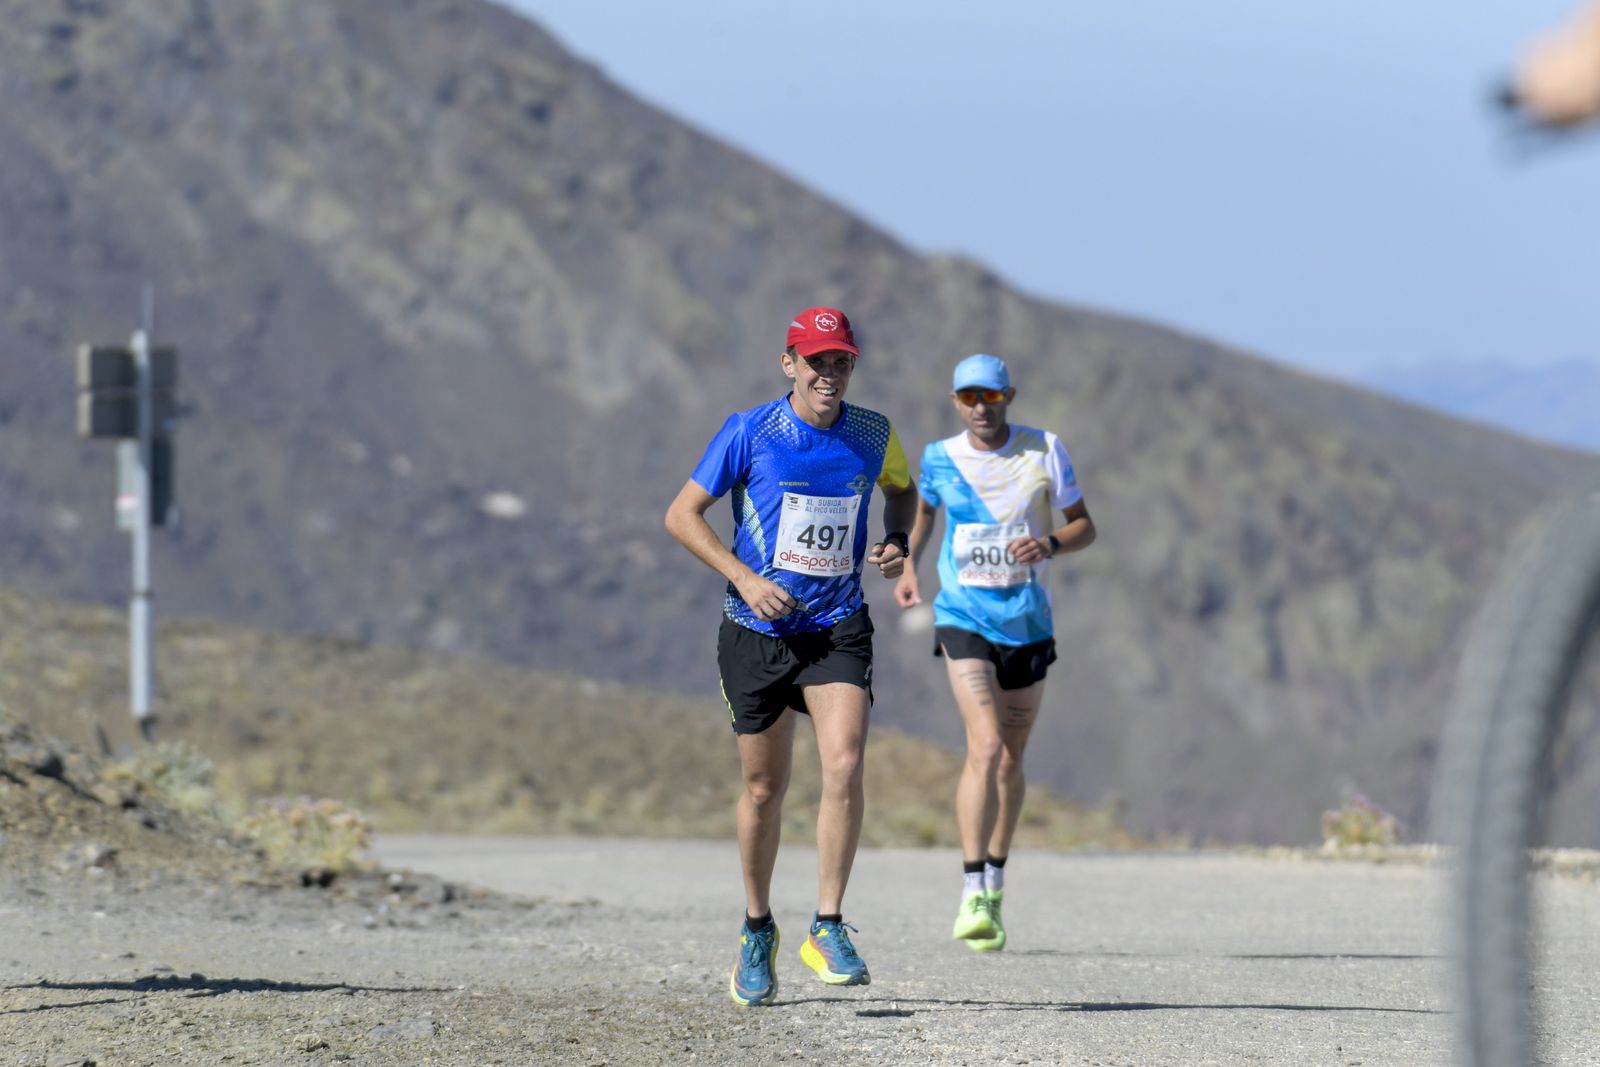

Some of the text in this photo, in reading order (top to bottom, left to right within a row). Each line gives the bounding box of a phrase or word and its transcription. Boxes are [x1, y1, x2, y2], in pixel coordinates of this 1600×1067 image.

[814, 506, 828, 514] PICO
[818, 498, 841, 507] SUBIDA
[797, 524, 849, 551] 497
[780, 550, 849, 570] alssport.es
[972, 546, 1017, 566] 800
